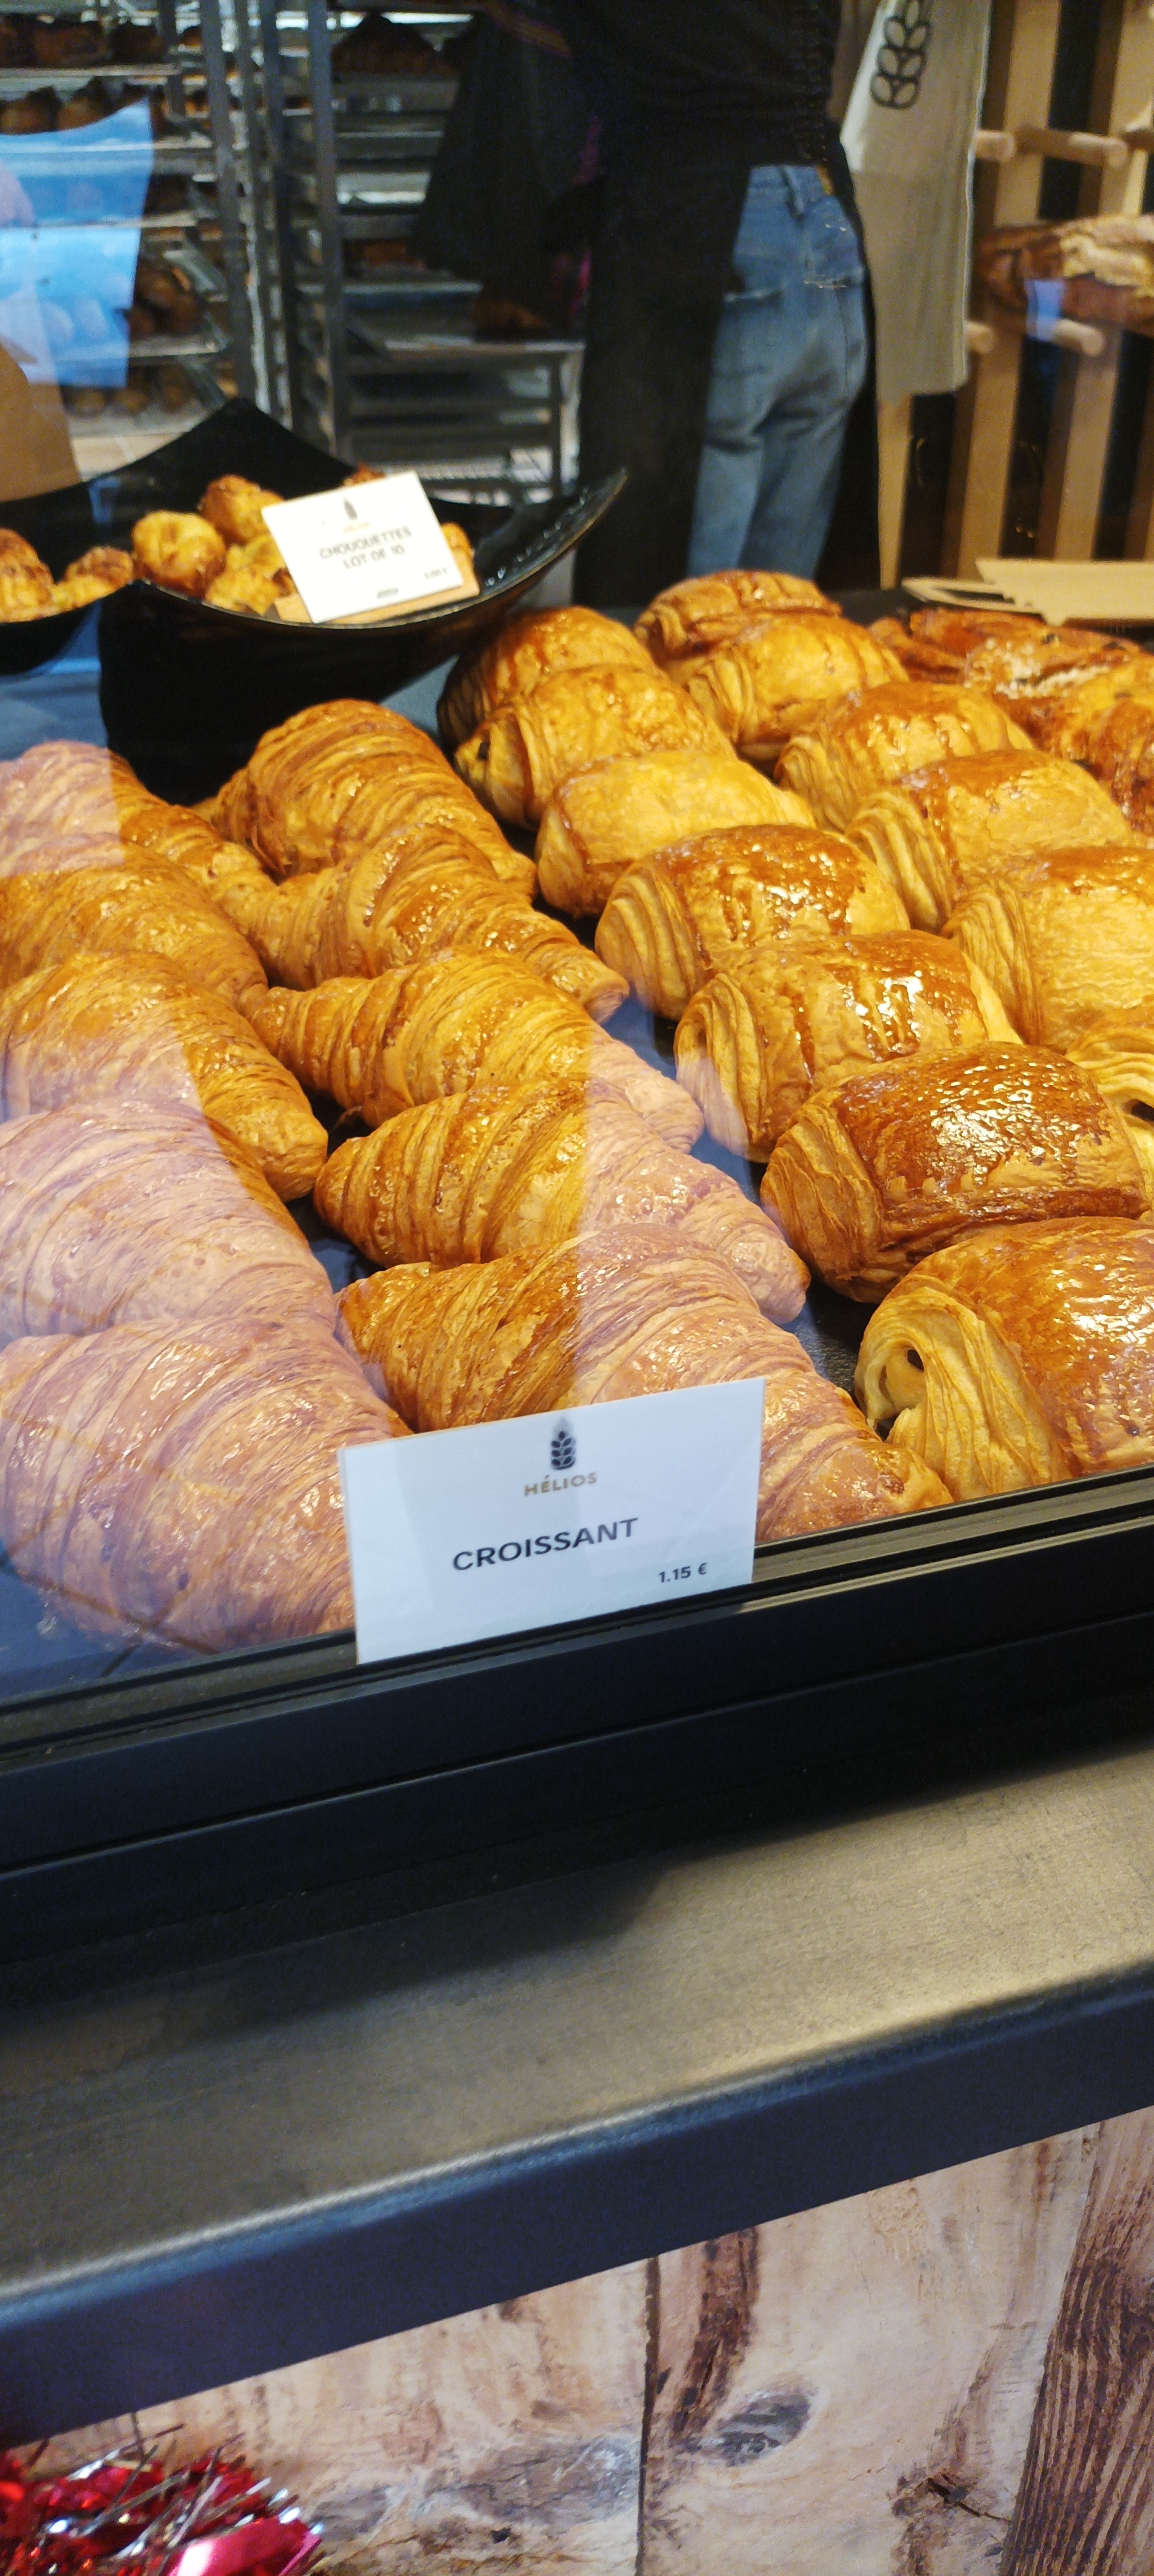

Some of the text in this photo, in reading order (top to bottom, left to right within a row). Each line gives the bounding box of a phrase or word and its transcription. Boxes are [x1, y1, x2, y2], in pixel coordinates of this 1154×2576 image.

[319, 526, 412, 559] CHOUQUETTES
[343, 544, 405, 569] LOT DE 10
[524, 1472, 598, 1496] HÉLIOS
[453, 1518, 639, 1571] CROISSANT
[659, 1563, 708, 1584] 1.15 €
